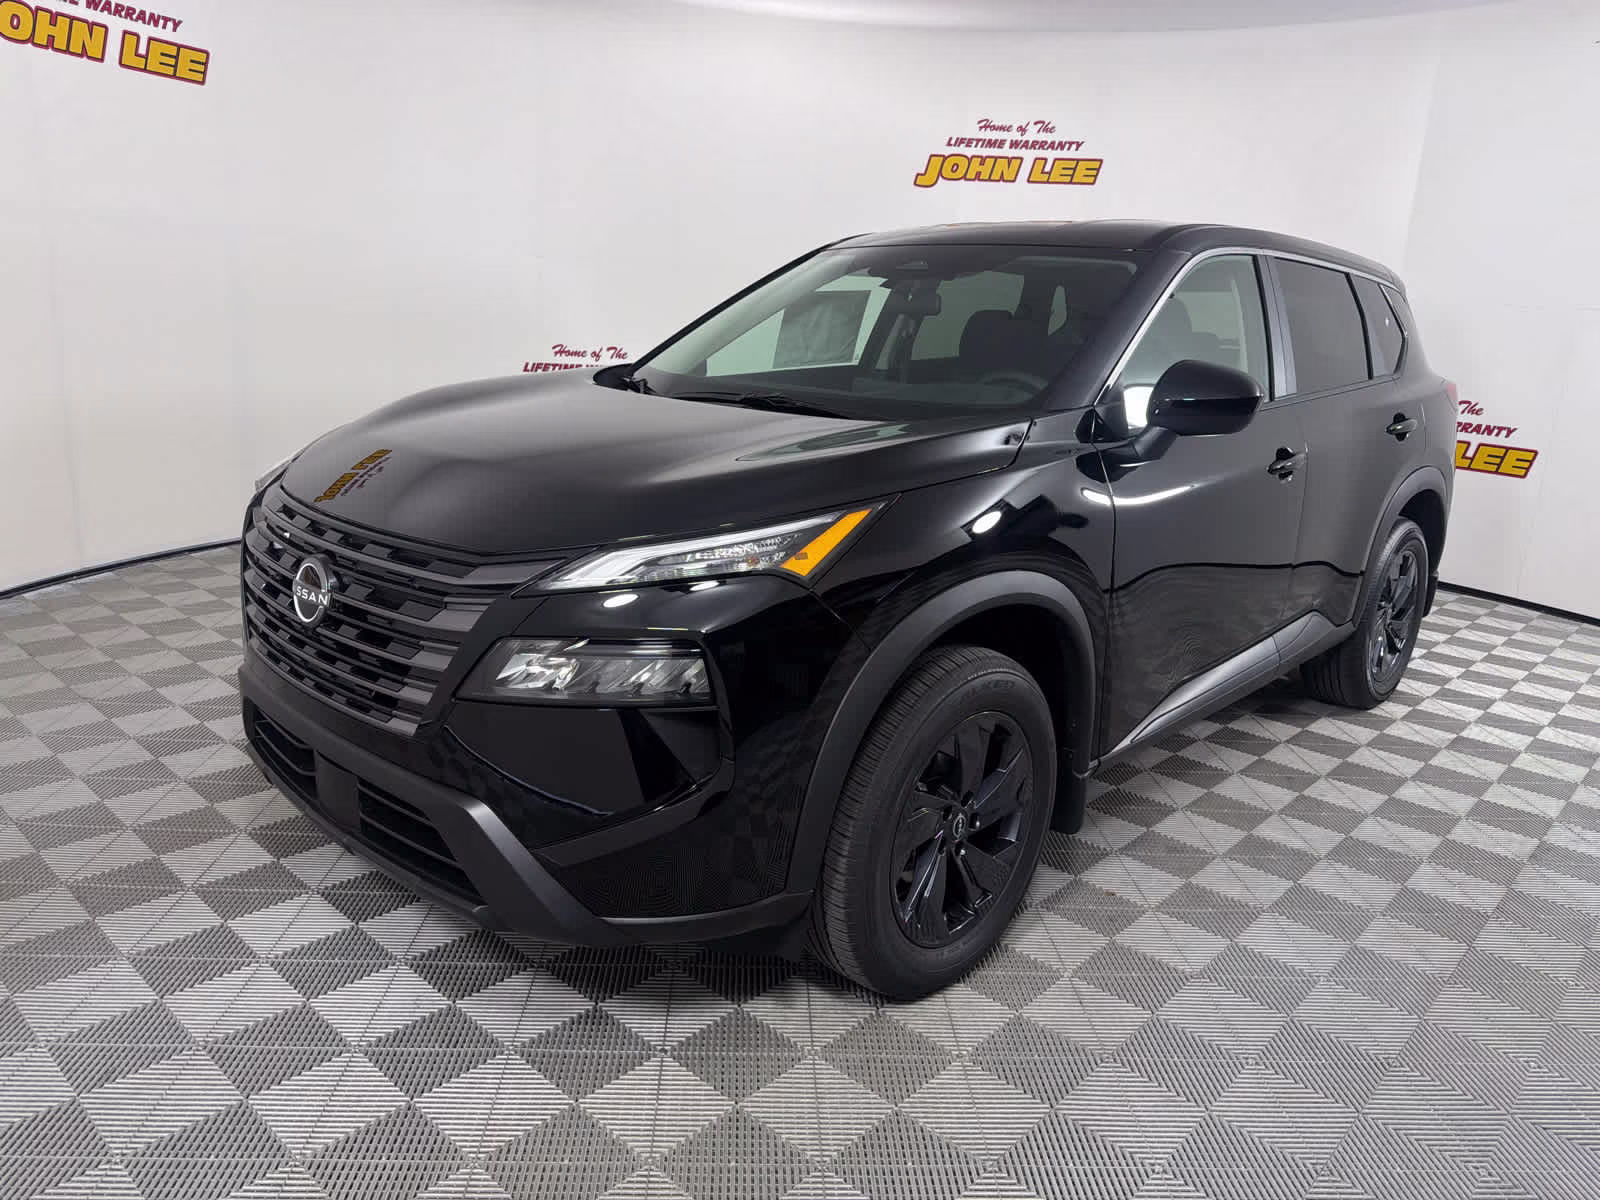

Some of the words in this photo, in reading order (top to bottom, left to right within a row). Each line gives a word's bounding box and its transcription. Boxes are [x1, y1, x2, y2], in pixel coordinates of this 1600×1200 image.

[0, 0, 109, 63] OHN
[118, 29, 210, 86] LEE
[977, 118, 1013, 134] Home
[1016, 122, 1029, 137] of
[1033, 120, 1056, 134] The
[946, 137, 1007, 149] LIFETIME
[1008, 139, 1085, 152] WARRANTY
[913, 153, 1024, 189] JOHN
[1027, 157, 1104, 186] LEE
[551, 343, 588, 358] Home
[590, 346, 603, 361] of
[606, 346, 628, 360] The
[1458, 400, 1484, 416] The
[1456, 421, 1518, 438] RRANTY
[1455, 440, 1539, 479] LEE
[296, 585, 328, 606] SSAN
